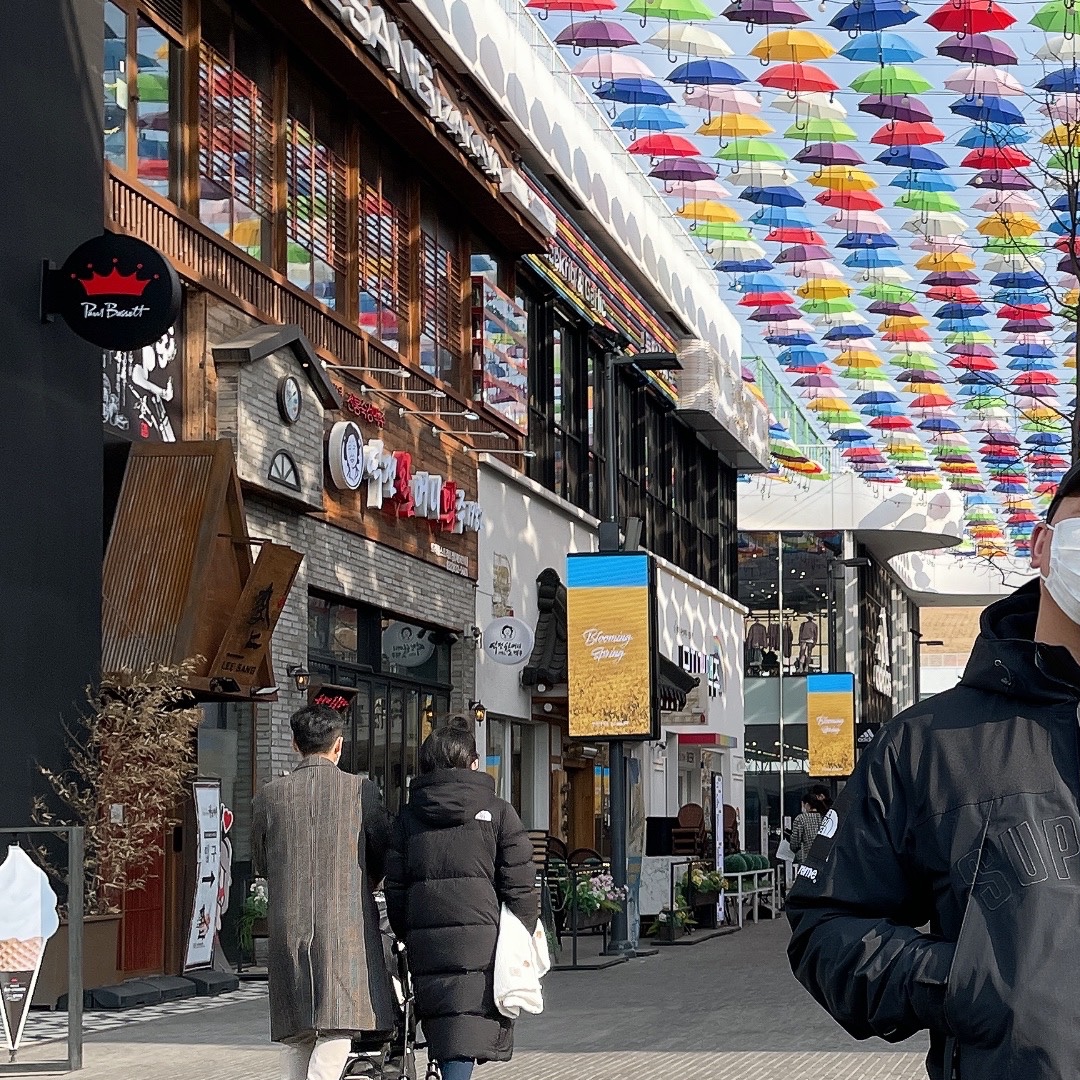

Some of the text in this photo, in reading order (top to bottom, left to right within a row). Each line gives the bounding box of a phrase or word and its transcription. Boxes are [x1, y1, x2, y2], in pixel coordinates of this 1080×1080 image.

[80, 301, 150, 319] Paul Bassett
[582, 628, 634, 648] Blooming
[591, 646, 625, 664] Spring
[221, 661, 257, 675] LEE SANG
